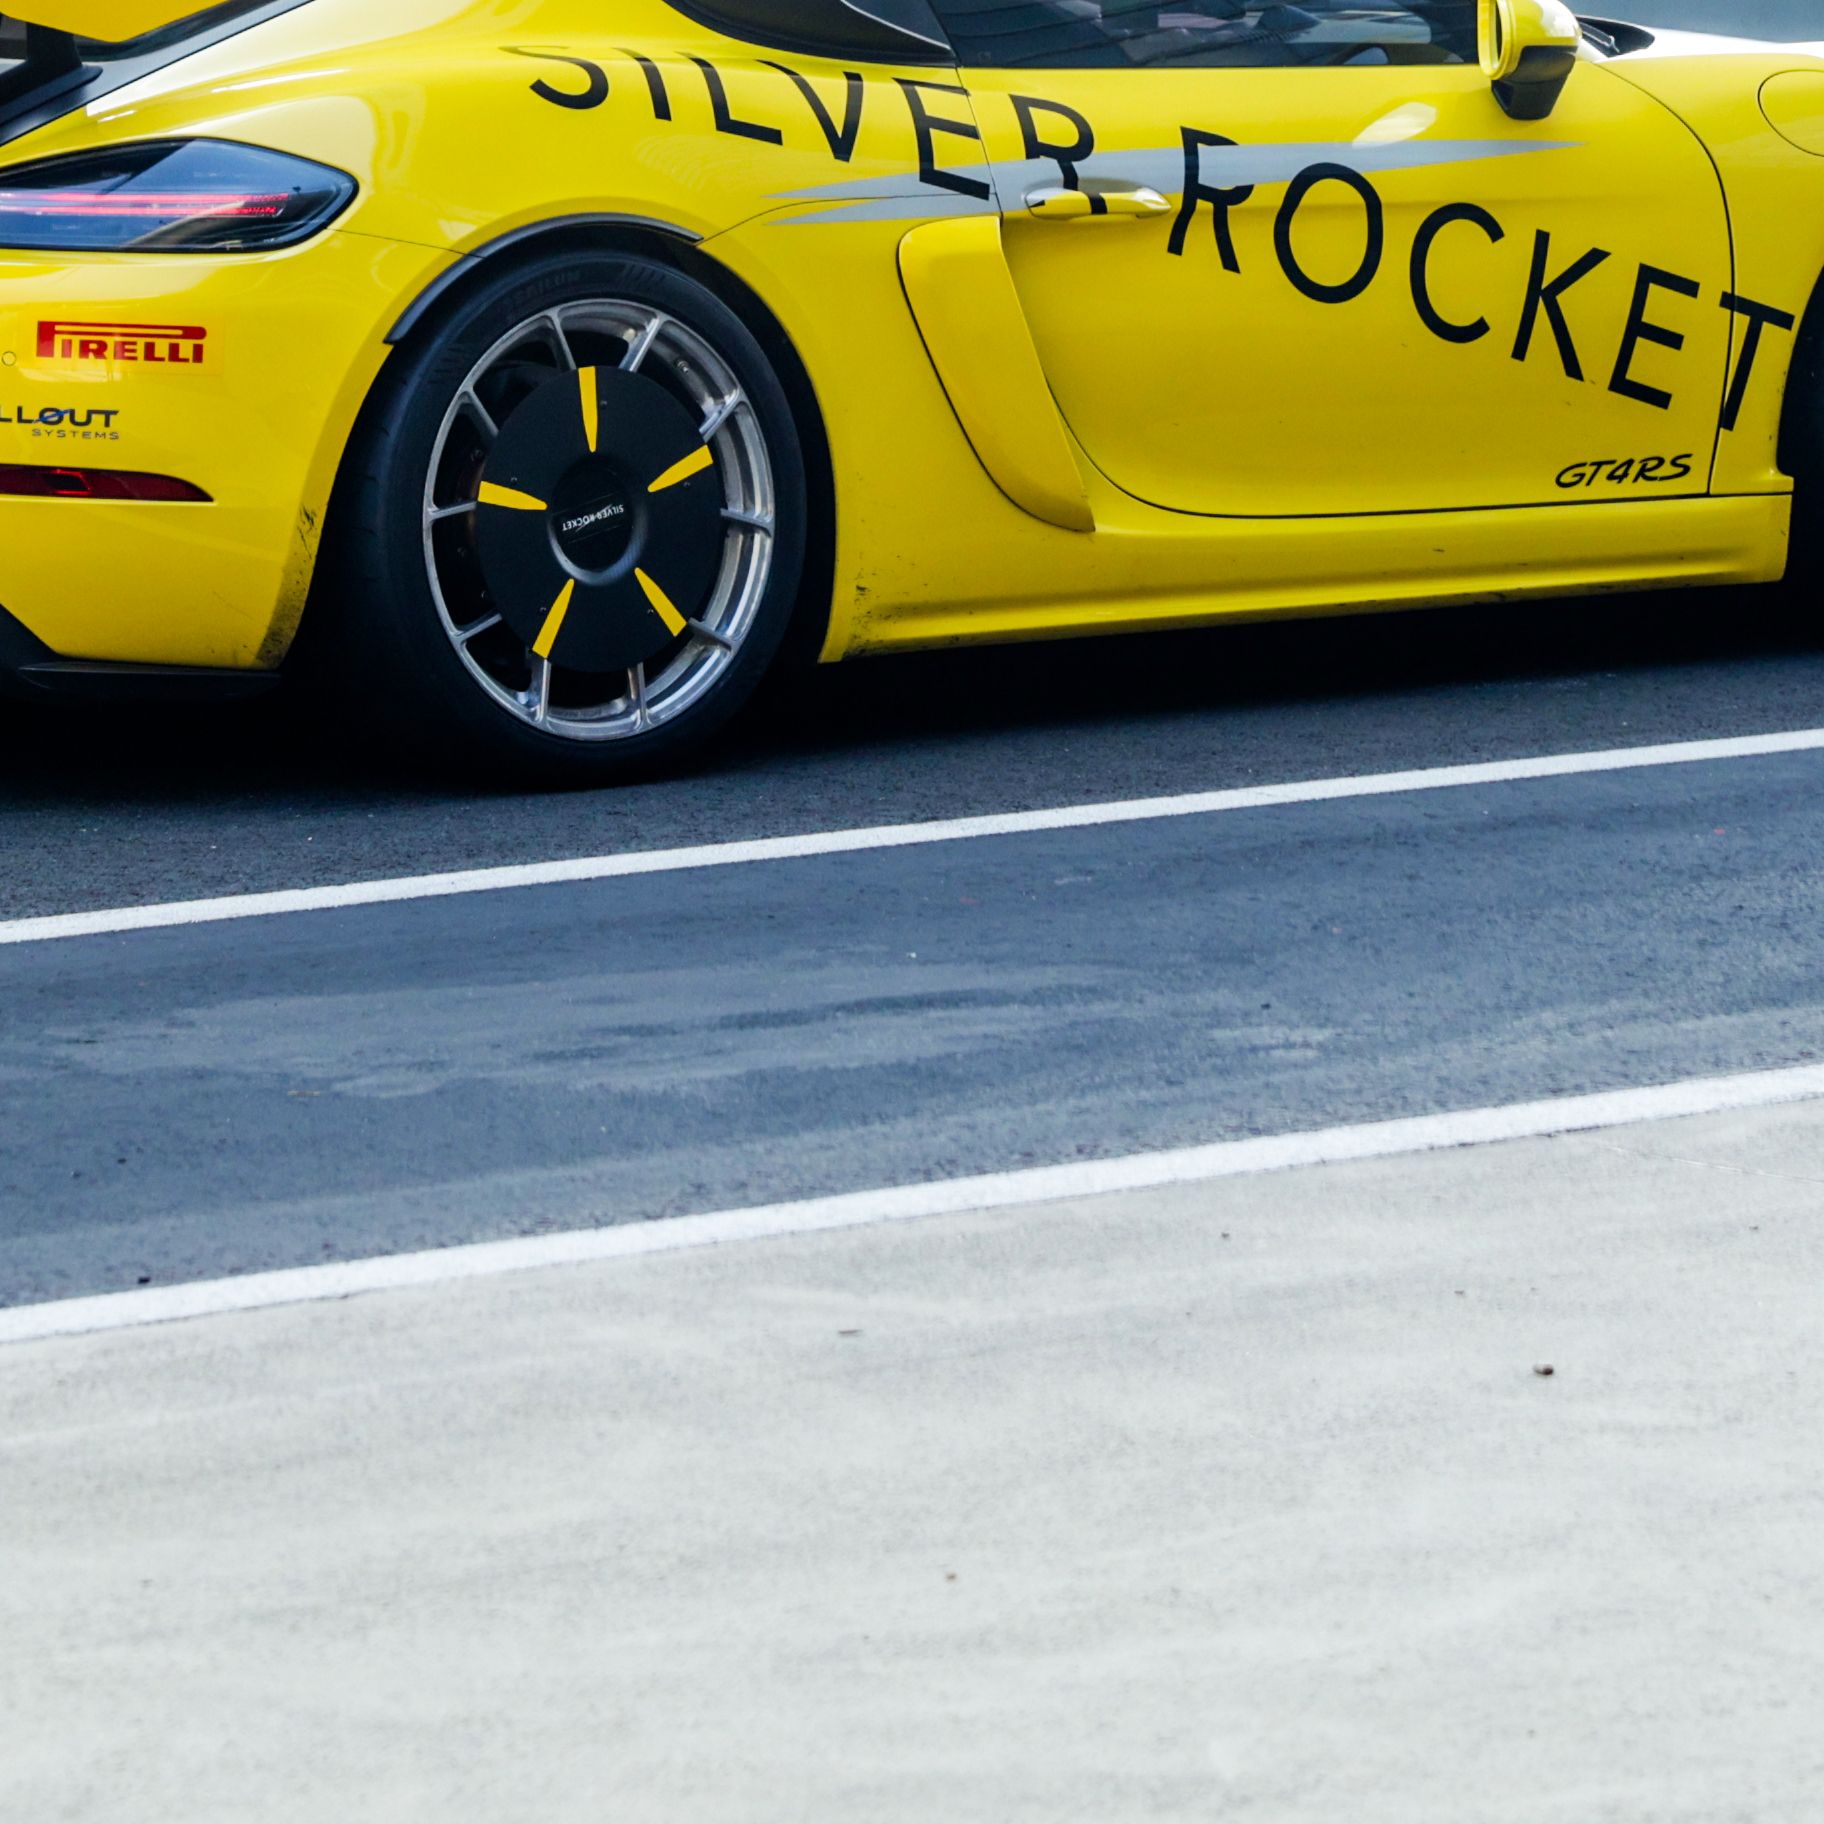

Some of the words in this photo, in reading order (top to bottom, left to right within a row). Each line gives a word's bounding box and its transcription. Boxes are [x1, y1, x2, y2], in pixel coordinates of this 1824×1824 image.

[498, 45, 1108, 214] SILVER
[1167, 125, 1796, 432] ROCKET
[36, 320, 208, 364] PIRELLI
[31, 428, 121, 441] SYSTEMS
[1554, 453, 1694, 489] GT4RS
